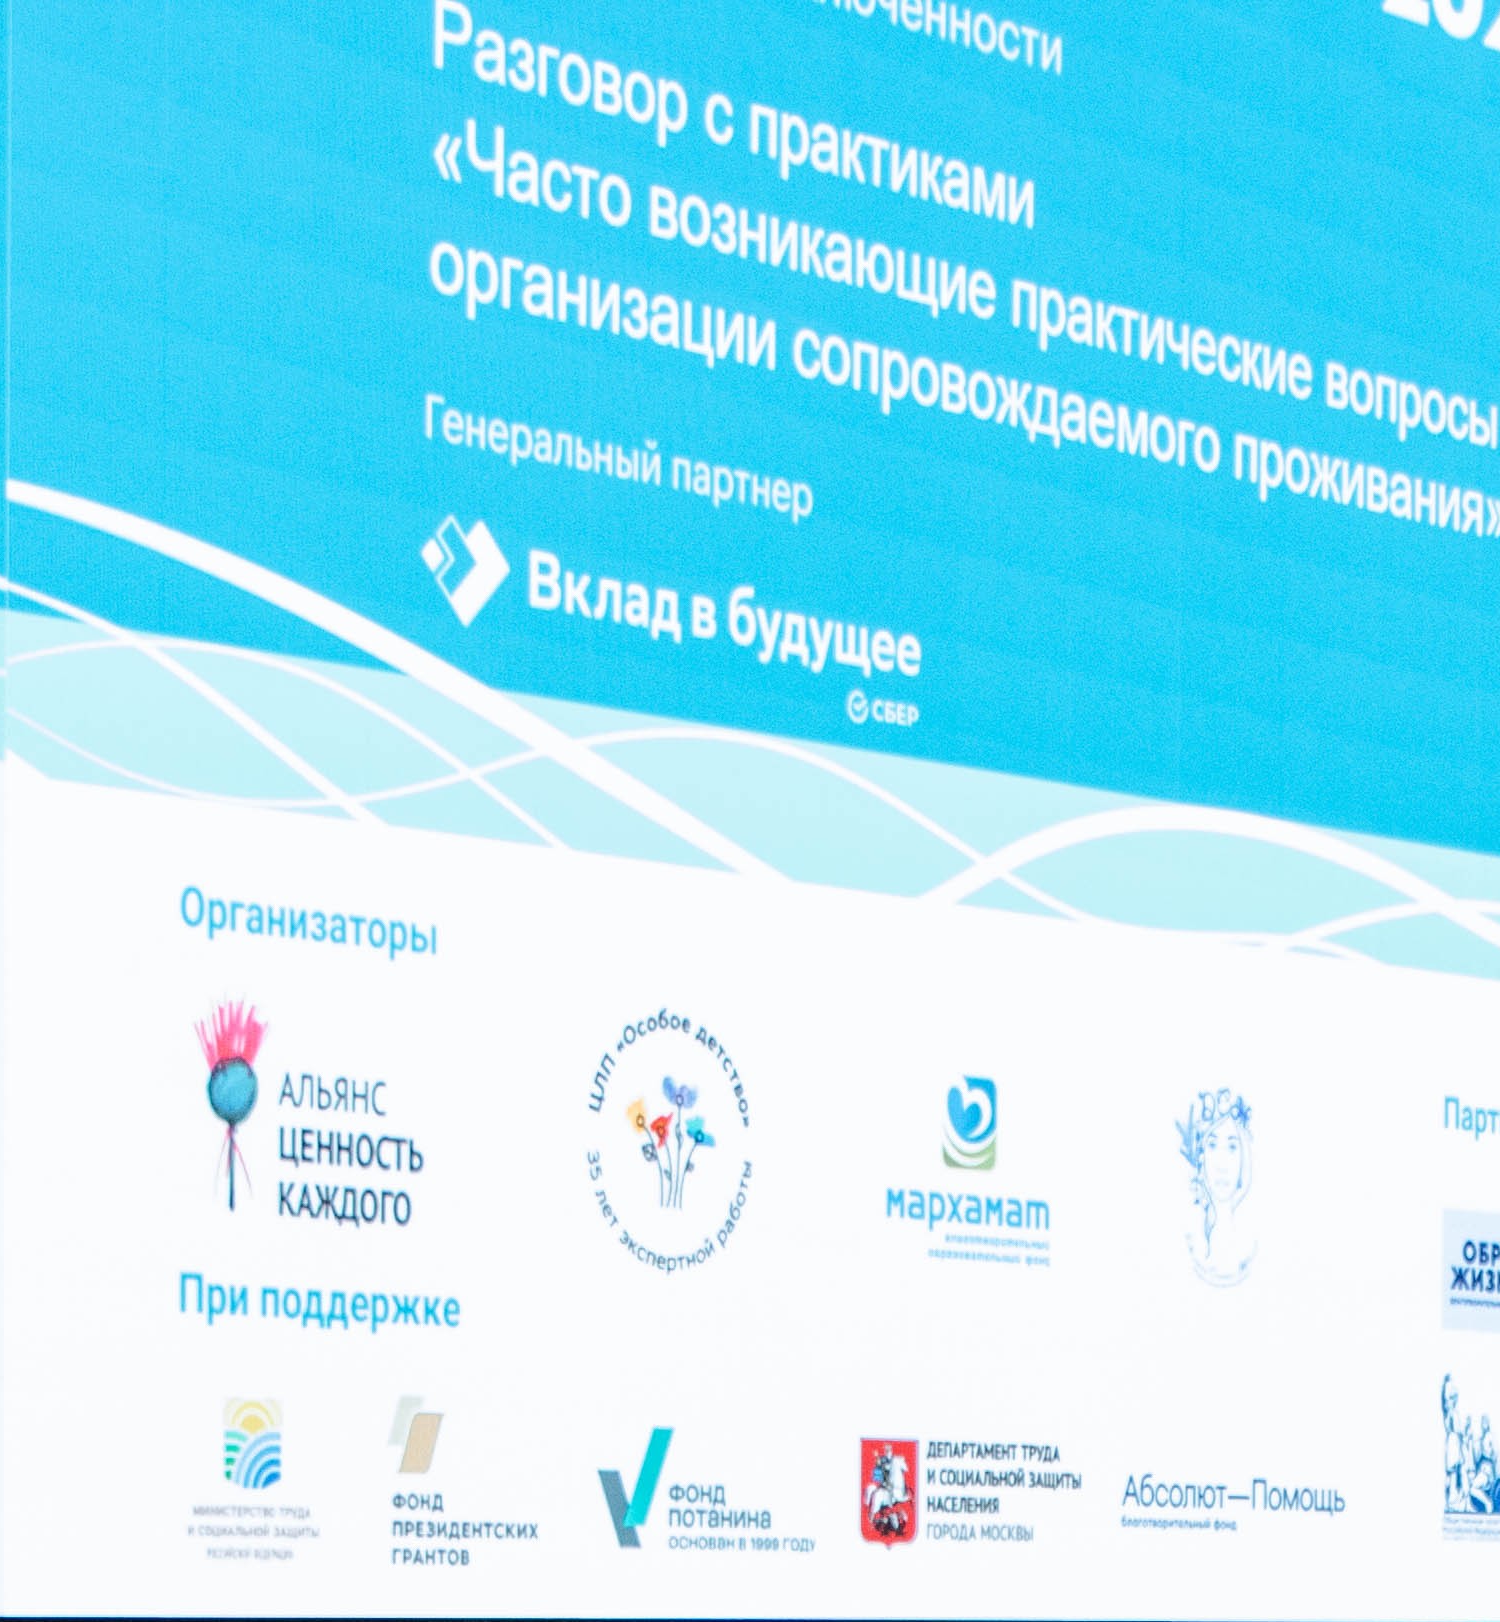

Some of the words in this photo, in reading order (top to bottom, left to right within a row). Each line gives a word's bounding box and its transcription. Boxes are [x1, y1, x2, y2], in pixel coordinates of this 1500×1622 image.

[433, 0, 688, 147] Разговор
[704, 92, 734, 145] с
[749, 103, 1034, 229] практиками
[433, 117, 632, 227] «Часто
[649, 184, 997, 319] возникающие
[1011, 278, 1313, 400] практические
[1325, 360, 1498, 449] вопросы
[429, 240, 776, 371] организации
[792, 327, 1221, 473] сопровождаемого
[424, 393, 661, 486] Генеральный
[671, 455, 813, 524] партнер
[528, 548, 682, 643] Вклад
[691, 594, 717, 639] в
[728, 584, 922, 678] будущее
[871, 698, 919, 726] СБЕР
[181, 886, 436, 960] Организаторы
[616, 1008, 691, 1052] «Особое
[695, 1026, 750, 1128] детство»
[279, 1073, 386, 1116] АЛЬЯНС
[280, 1127, 423, 1172] ЦЕННОСТЬ
[279, 1182, 411, 1227] КАЖДОГО
[619, 1229, 716, 1275] экспертной
[716, 1159, 754, 1249] работы
[887, 1188, 1049, 1230] мархамат
[180, 1272, 248, 1325] При
[261, 1287, 460, 1333] поддержке
[927, 1441, 1017, 1460] ДЕПАРТАМЕНТ
[1021, 1444, 1060, 1463] ТРУДА
[669, 1484, 726, 1507] ФОНД
[927, 1469, 935, 1484] И
[940, 1468, 1025, 1487] СОЦИАЛЬНОЙ
[1029, 1472, 1081, 1490] ЗАЩИТЫ
[392, 1493, 444, 1512] ФОНД
[927, 1496, 999, 1513] НАСЕЛЕНИЯ
[393, 1520, 538, 1540] ПРЕЗИДЕНТСКИХ
[927, 1523, 976, 1541] ГОРОДА
[981, 1524, 1033, 1542] МОСКВЫ
[392, 1548, 469, 1566] ГРАНТОВ
